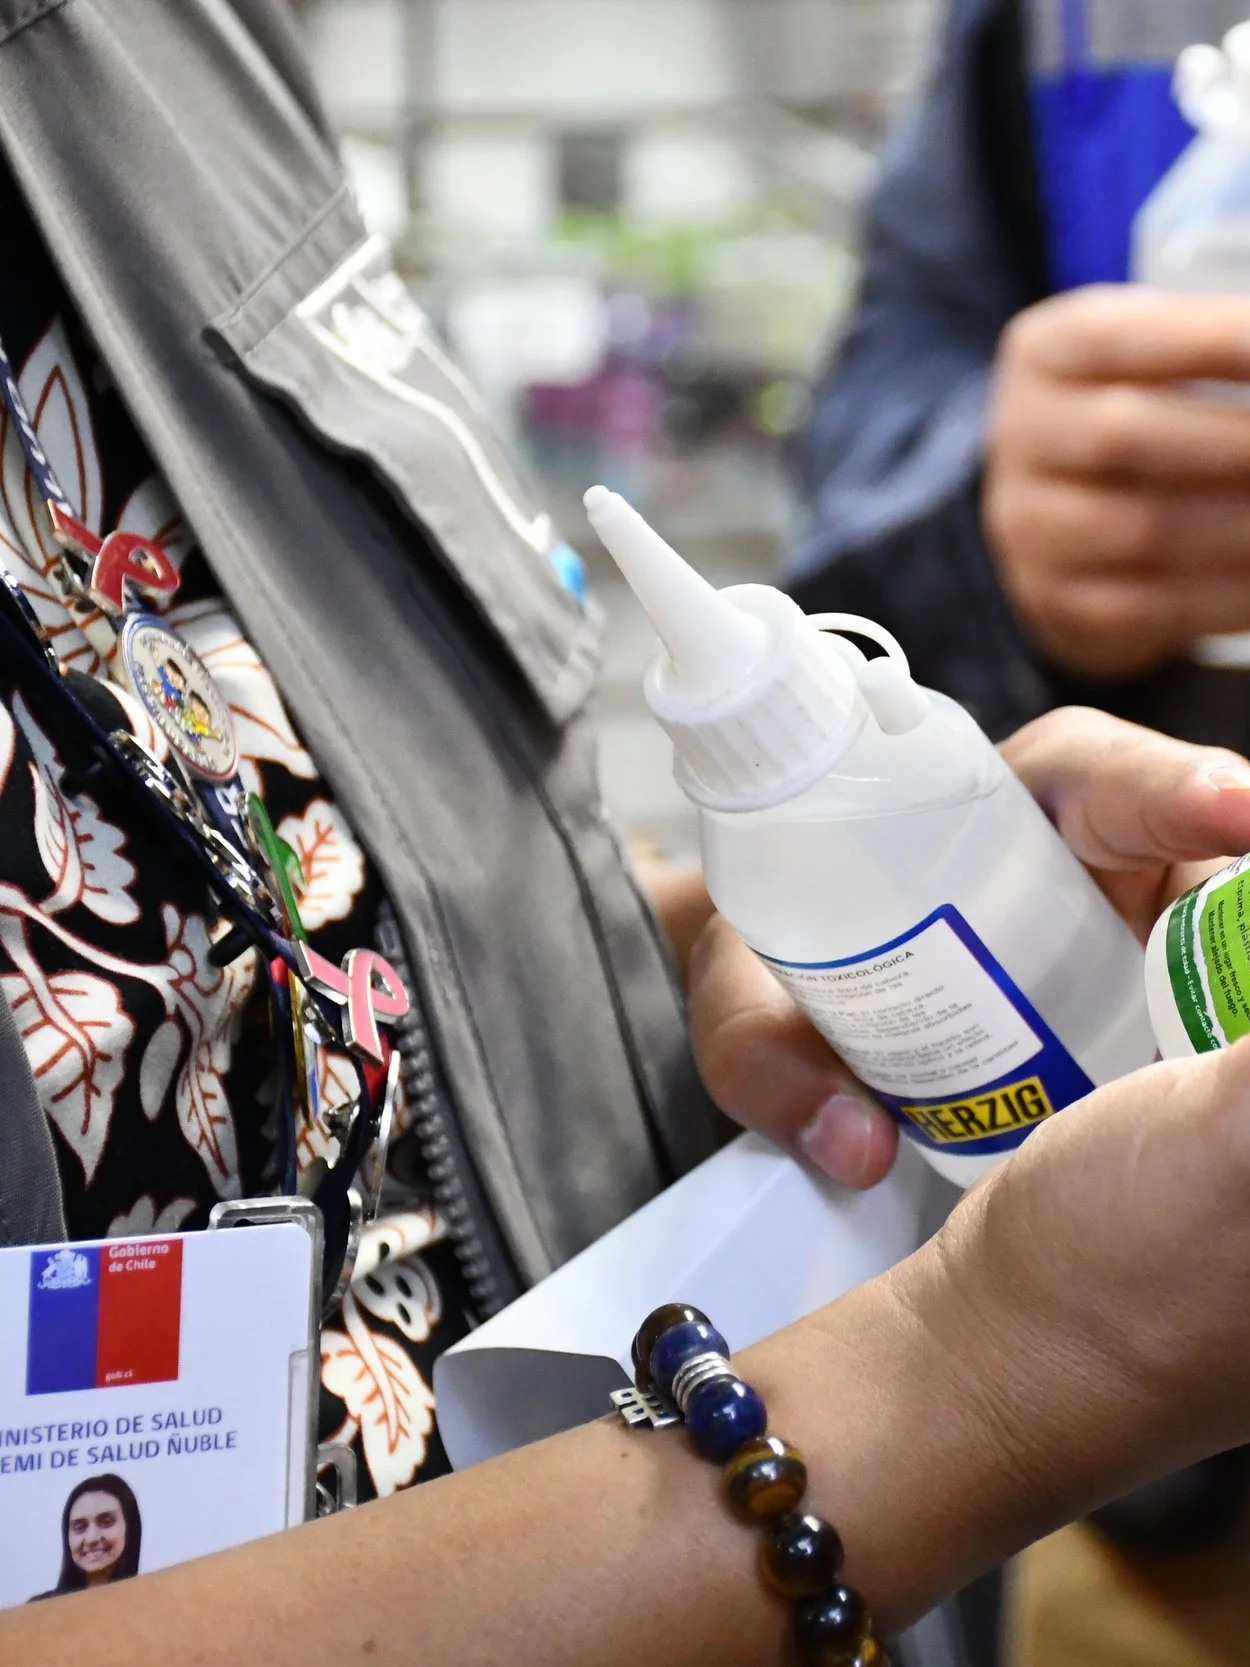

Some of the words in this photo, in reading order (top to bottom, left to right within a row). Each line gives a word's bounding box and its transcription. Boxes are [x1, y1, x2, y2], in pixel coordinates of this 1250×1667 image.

[819, 951, 914, 982] TOXICOLÓGICA
[1211, 945, 1223, 974] alejado
[1219, 975, 1229, 989] del
[1224, 989, 1238, 1018] fuego.
[1224, 950, 1233, 970] lugar
[1229, 971, 1242, 996] fresco
[1188, 980, 1198, 1003] Evitar
[1195, 1005, 1213, 1039] contacto
[905, 1084, 1046, 1139] HERZIG
[108, 1262, 124, 1272] de
[126, 1258, 156, 1271] Chile
[109, 1244, 169, 1259] Gobierno
[0, 1419, 108, 1447] INISTERIO
[116, 1415, 144, 1435] DE
[151, 1407, 222, 1431] SALUD
[1, 1452, 42, 1474] EMI
[50, 1448, 80, 1468] DE
[87, 1440, 160, 1464] SALUD
[167, 1430, 238, 1456] ÑUBLE
